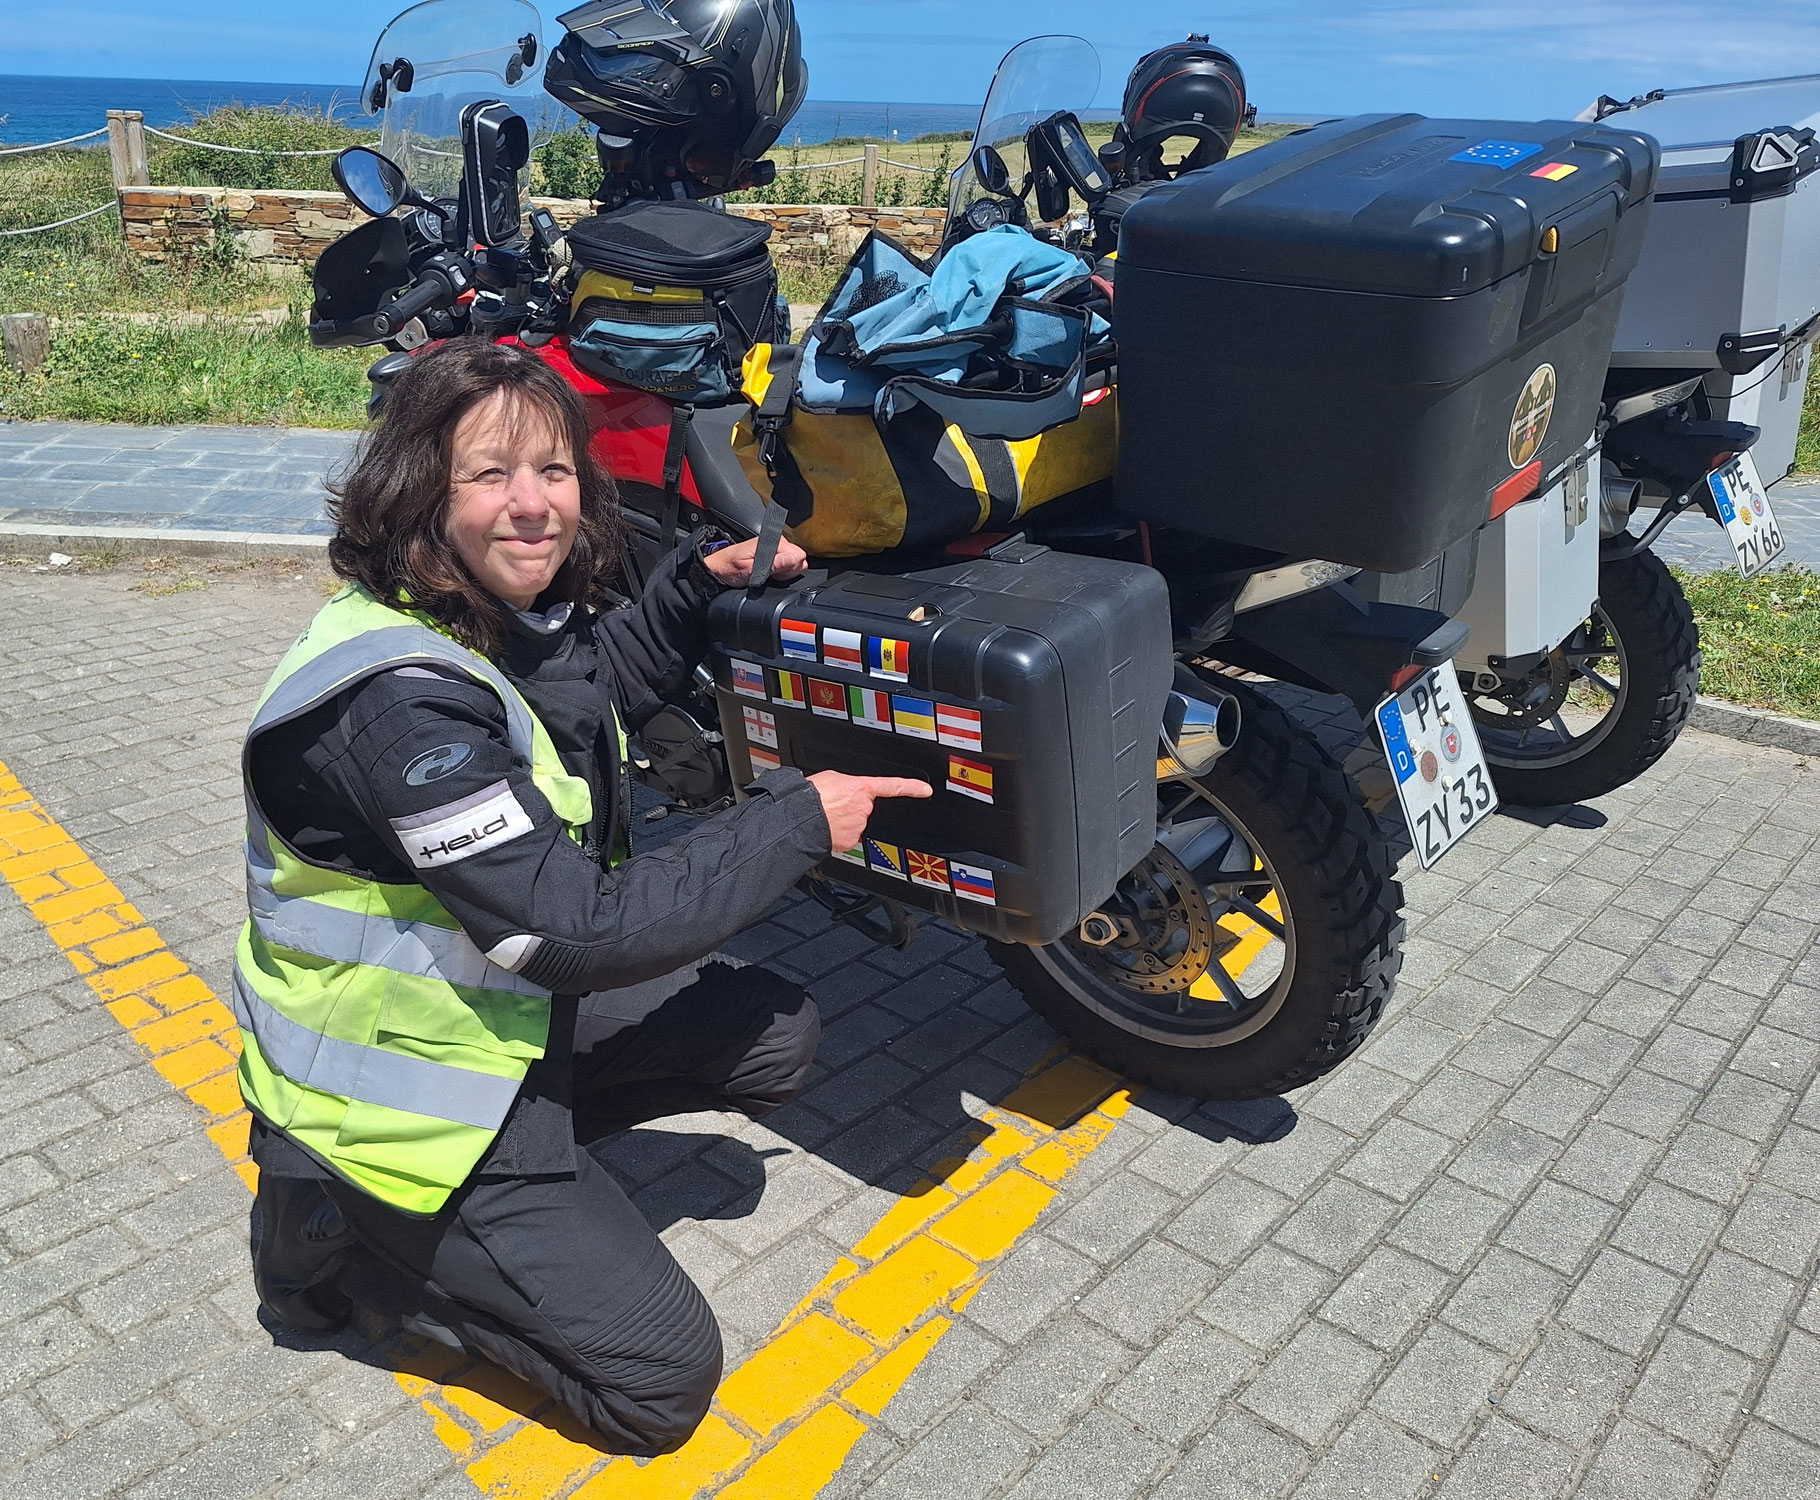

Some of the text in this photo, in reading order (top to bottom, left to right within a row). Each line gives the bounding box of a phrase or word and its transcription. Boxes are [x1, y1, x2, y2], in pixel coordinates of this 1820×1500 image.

[1724, 460, 1750, 498] PE
[1722, 503, 1731, 517] D
[1411, 669, 1450, 733] PE
[1396, 750, 1409, 771] D
[419, 813, 509, 860] Held
